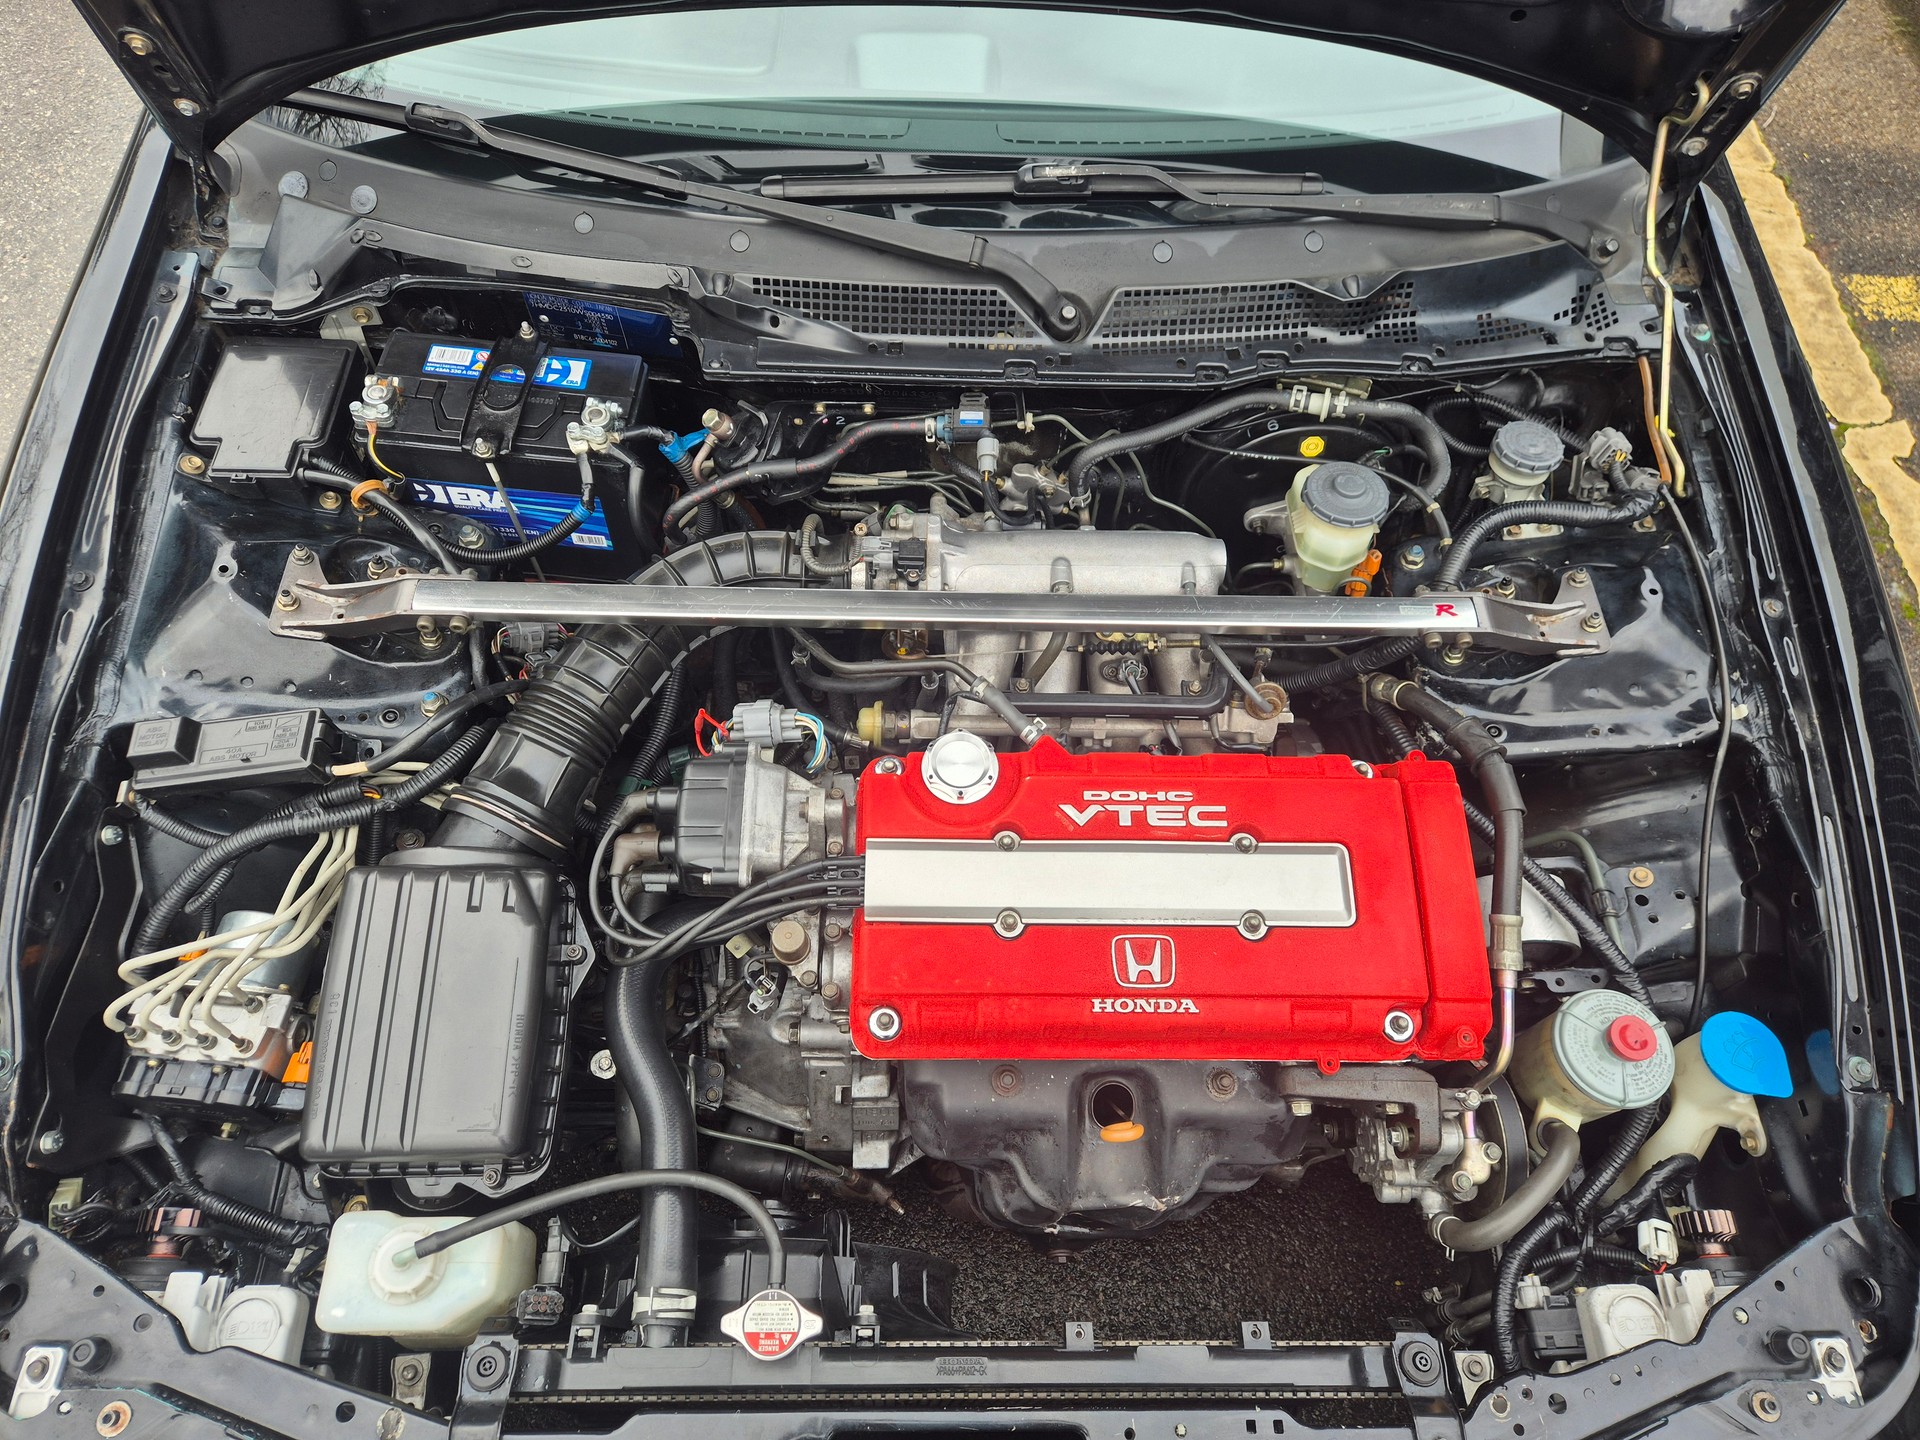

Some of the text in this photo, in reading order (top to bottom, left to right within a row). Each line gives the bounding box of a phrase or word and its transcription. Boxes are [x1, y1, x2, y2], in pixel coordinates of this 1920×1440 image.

[446, 486, 520, 514] ERA
[1434, 603, 1459, 617] R
[137, 739, 164, 748] RELAY
[229, 751, 257, 760] MOTOR
[1083, 790, 1194, 802] DOHC
[1058, 804, 1228, 827] VTEC
[1092, 998, 1200, 1013] HONDA
[512, 1014, 525, 1051] HONDA
